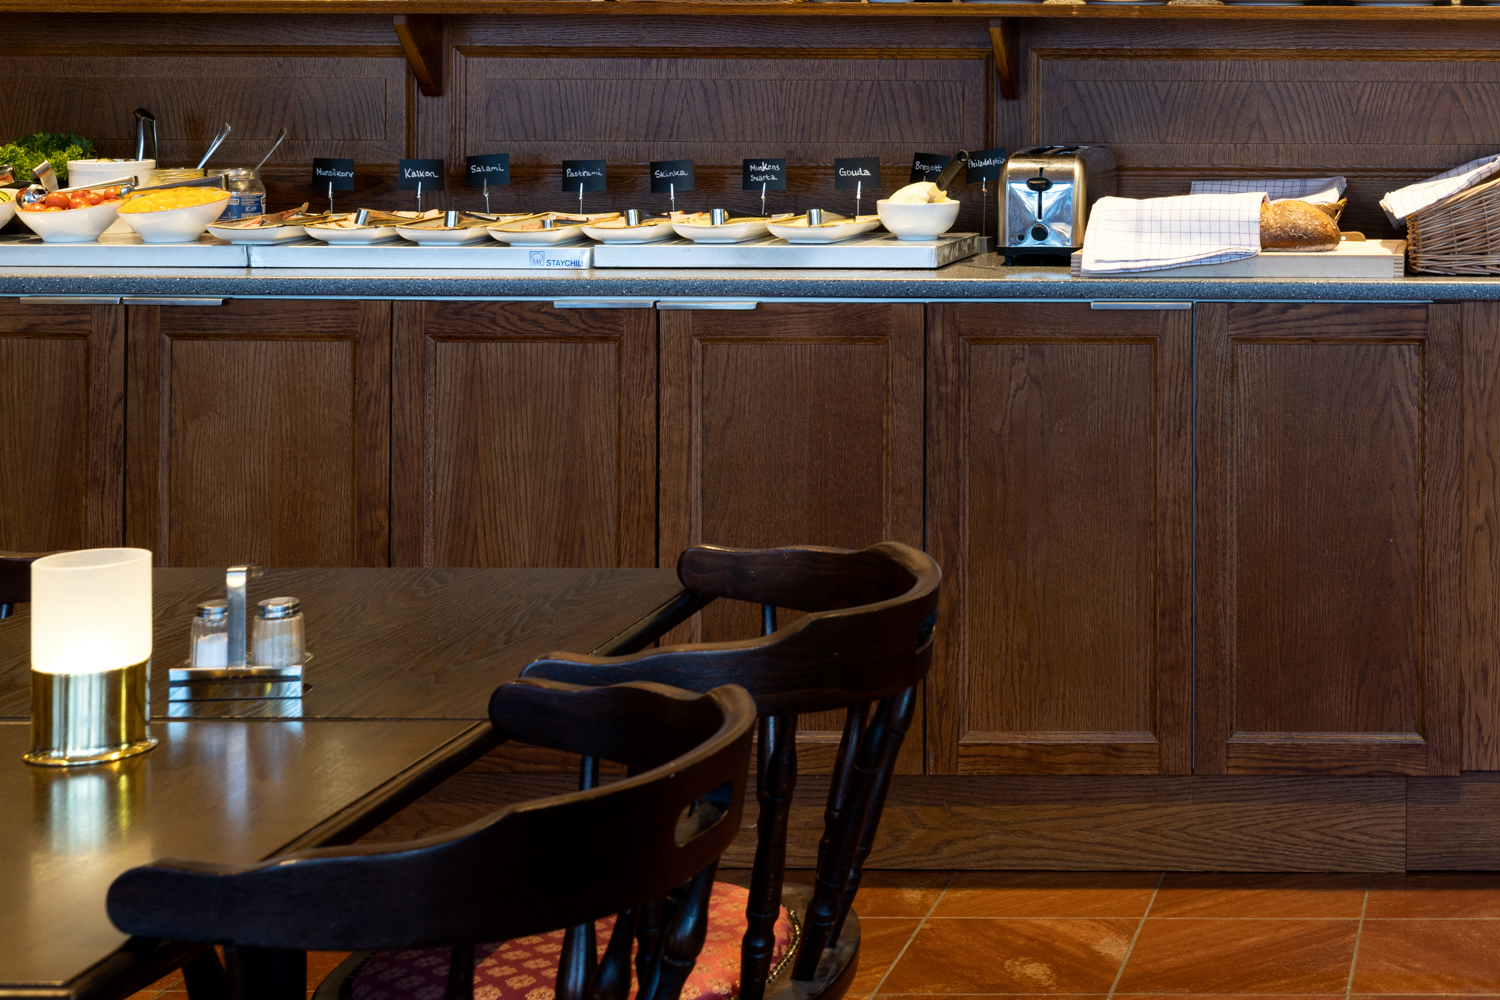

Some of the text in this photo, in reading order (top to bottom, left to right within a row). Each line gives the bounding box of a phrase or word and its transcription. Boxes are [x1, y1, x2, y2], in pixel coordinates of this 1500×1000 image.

[470, 163, 505, 173] Salami
[914, 160, 943, 174] Bregott
[967, 156, 1006, 170] Philadelphia
[404, 168, 439, 178] Kalkon
[566, 168, 603, 178] Pastrami
[654, 169, 689, 179] Skinka
[838, 167, 872, 177] Gouda
